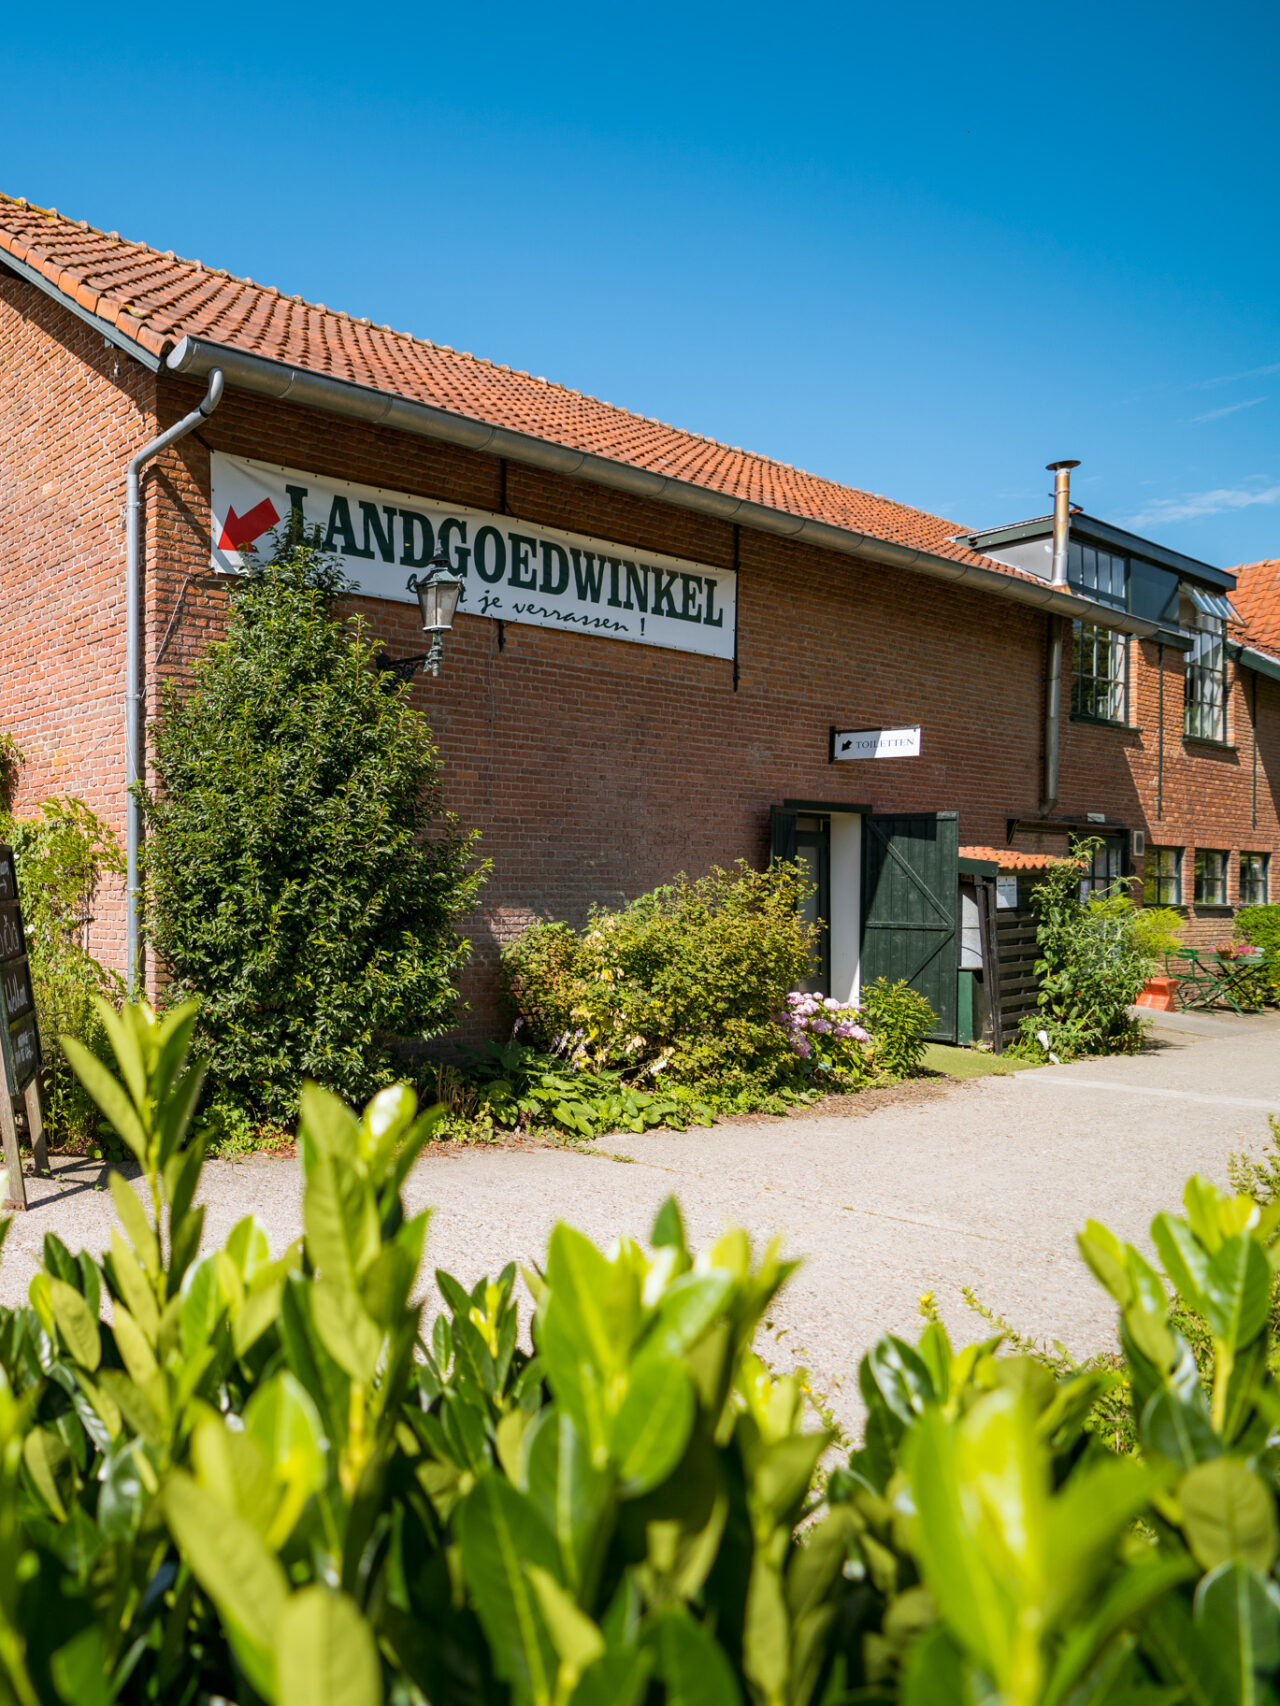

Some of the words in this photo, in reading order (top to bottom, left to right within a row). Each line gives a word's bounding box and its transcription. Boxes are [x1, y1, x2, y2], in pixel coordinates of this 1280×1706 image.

[285, 484, 724, 628] LANDGOEDWINKEL
[478, 589, 503, 614] je
[512, 602, 629, 632] verrassen
[855, 738, 915, 749] TOILETTEN
